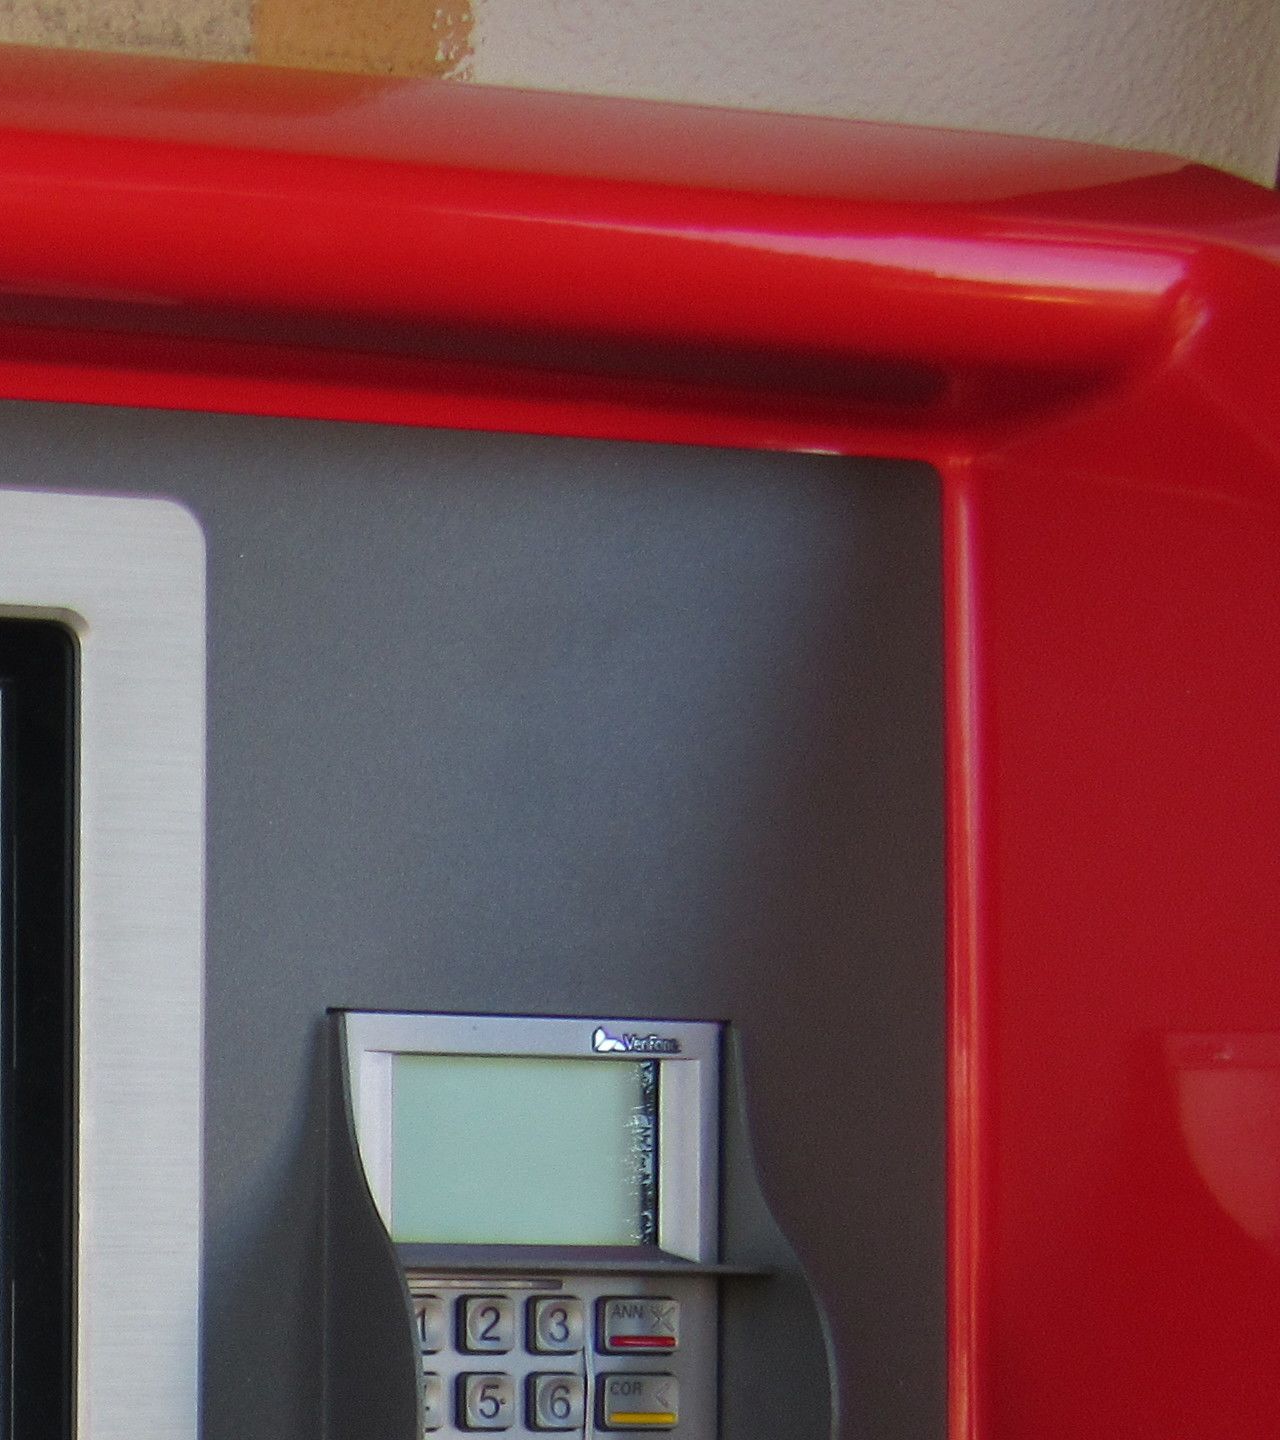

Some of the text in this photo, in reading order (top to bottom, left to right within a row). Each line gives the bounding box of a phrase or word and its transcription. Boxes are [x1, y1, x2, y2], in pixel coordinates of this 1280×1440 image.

[479, 1306, 501, 1342] 2
[548, 1308, 570, 1343] 3
[611, 1304, 644, 1320] ANN
[478, 1383, 501, 1419] 5
[549, 1384, 571, 1419] 6
